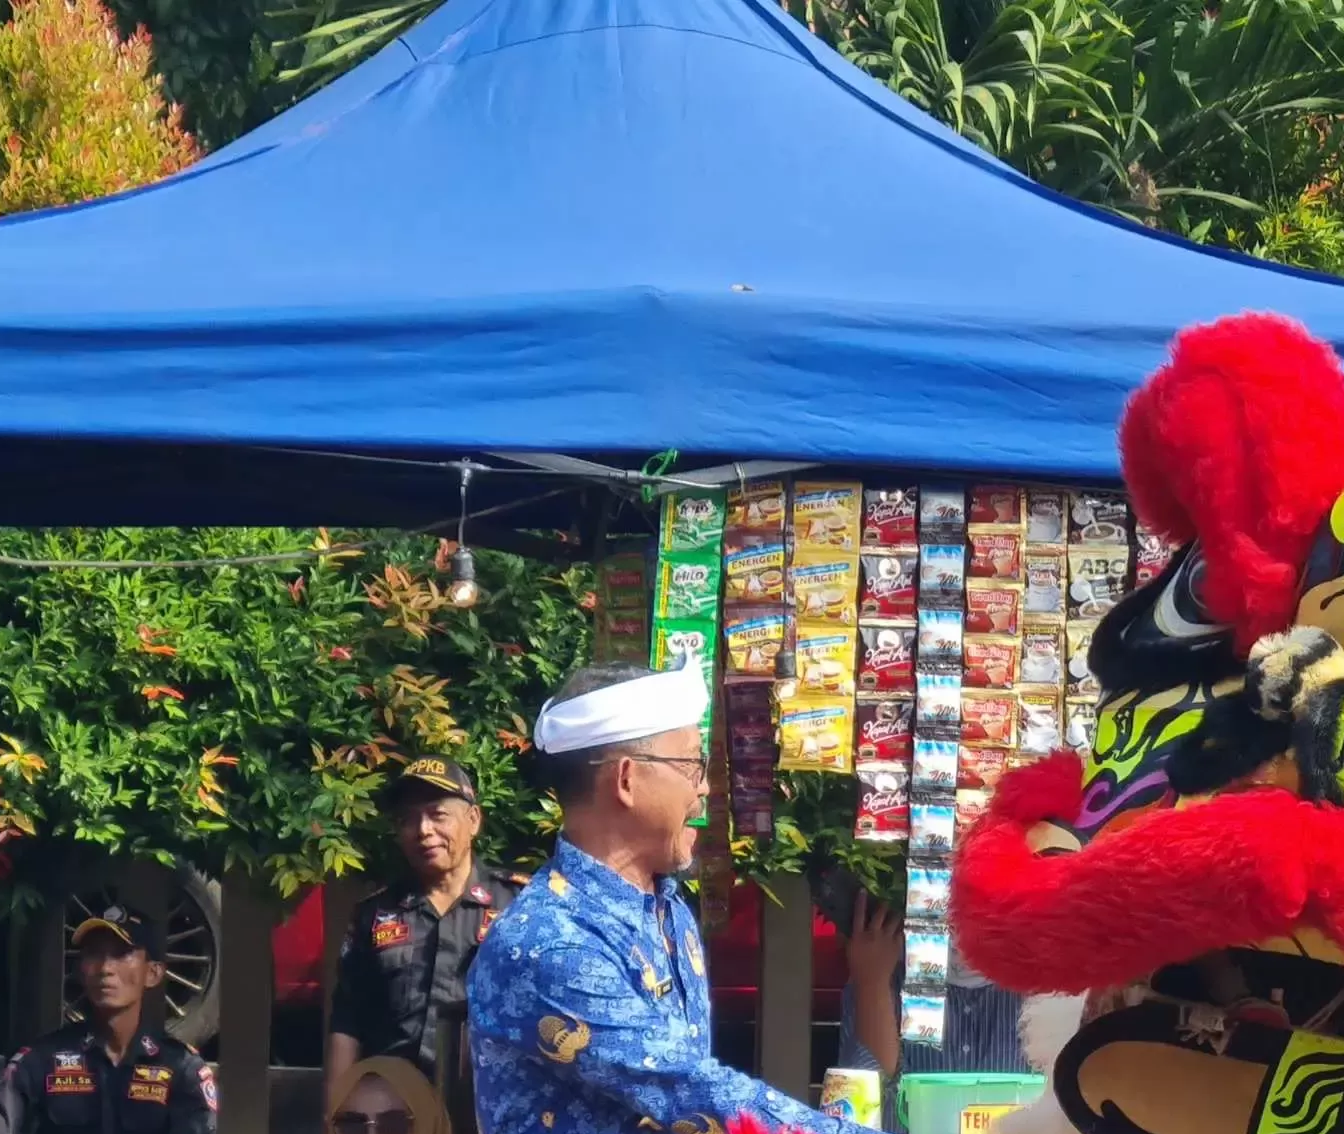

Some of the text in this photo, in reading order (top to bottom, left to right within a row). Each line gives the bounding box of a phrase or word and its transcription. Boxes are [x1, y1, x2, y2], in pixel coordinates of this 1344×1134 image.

[732, 554, 781, 569] ENERGEN
[1078, 558, 1127, 576] ABC
[674, 570, 705, 583] MILO
[863, 720, 893, 739] Kapal
[862, 792, 893, 811] Kapal
[963, 1111, 991, 1130] TEH
